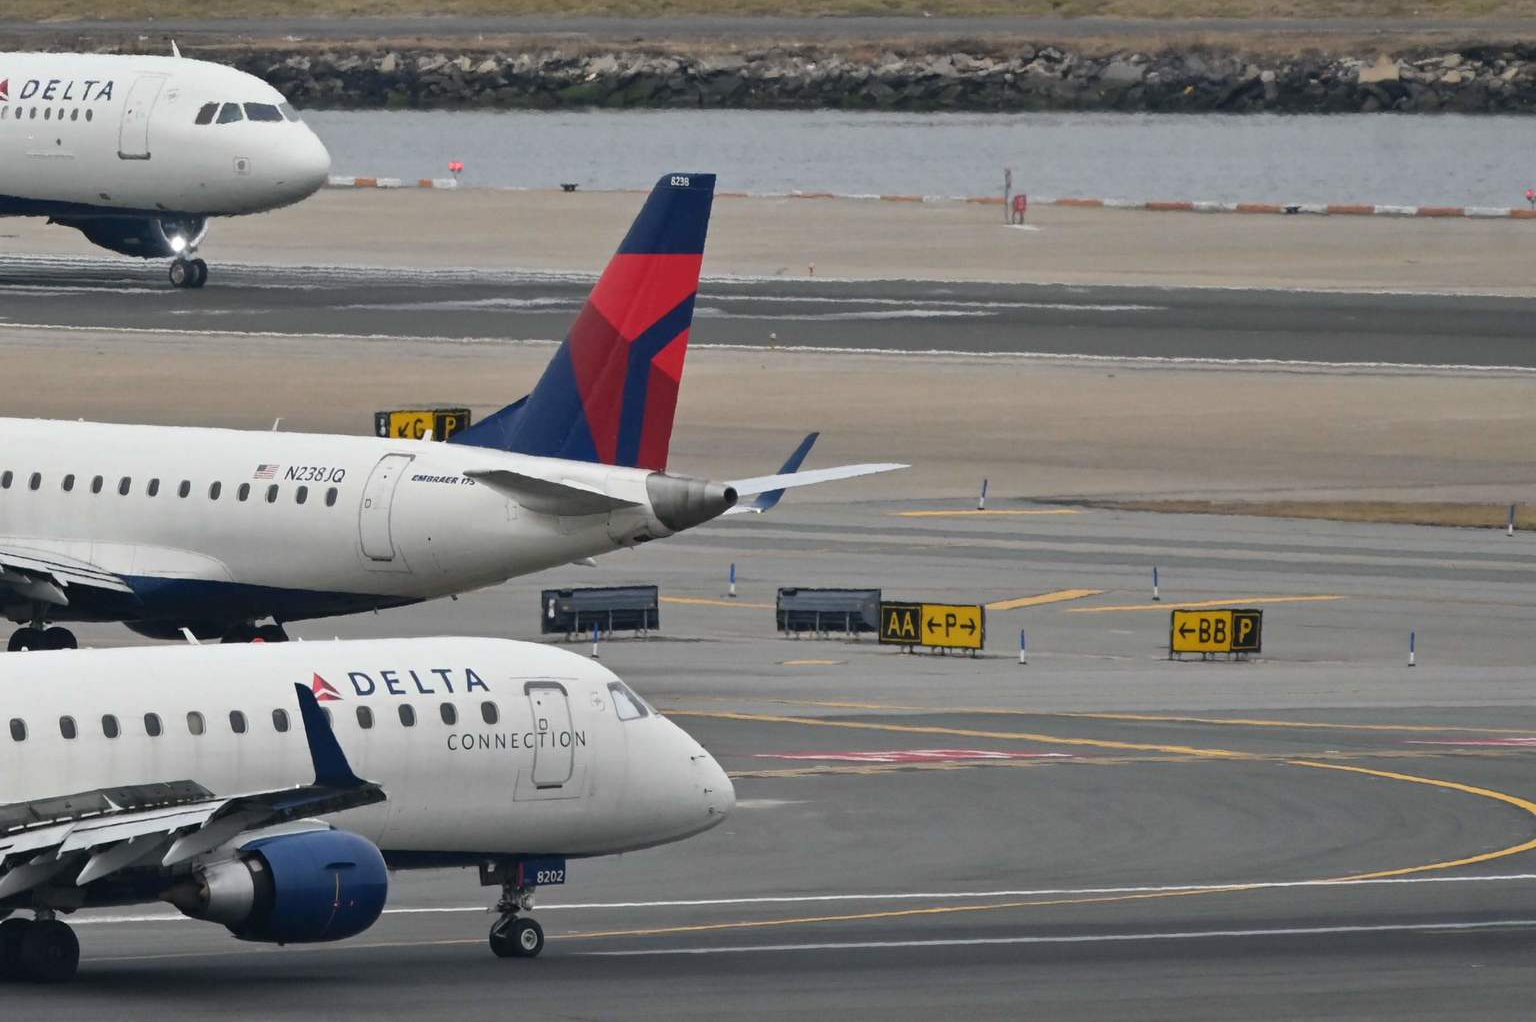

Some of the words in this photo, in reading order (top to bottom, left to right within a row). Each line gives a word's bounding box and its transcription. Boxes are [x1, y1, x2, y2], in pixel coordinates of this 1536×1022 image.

[19, 79, 114, 101] DELTA
[670, 176, 690, 187] 8238
[413, 418, 425, 440] G
[445, 417, 457, 441] P
[284, 465, 346, 483] N238JQ
[411, 474, 459, 485] EMBRAER
[887, 611, 915, 637] AA
[945, 613, 957, 638] P
[1199, 618, 1227, 644] BB
[1239, 618, 1253, 643] P
[348, 668, 491, 696] DELTA
[447, 730, 586, 751] CONNECTION
[536, 870, 564, 884] 8202
